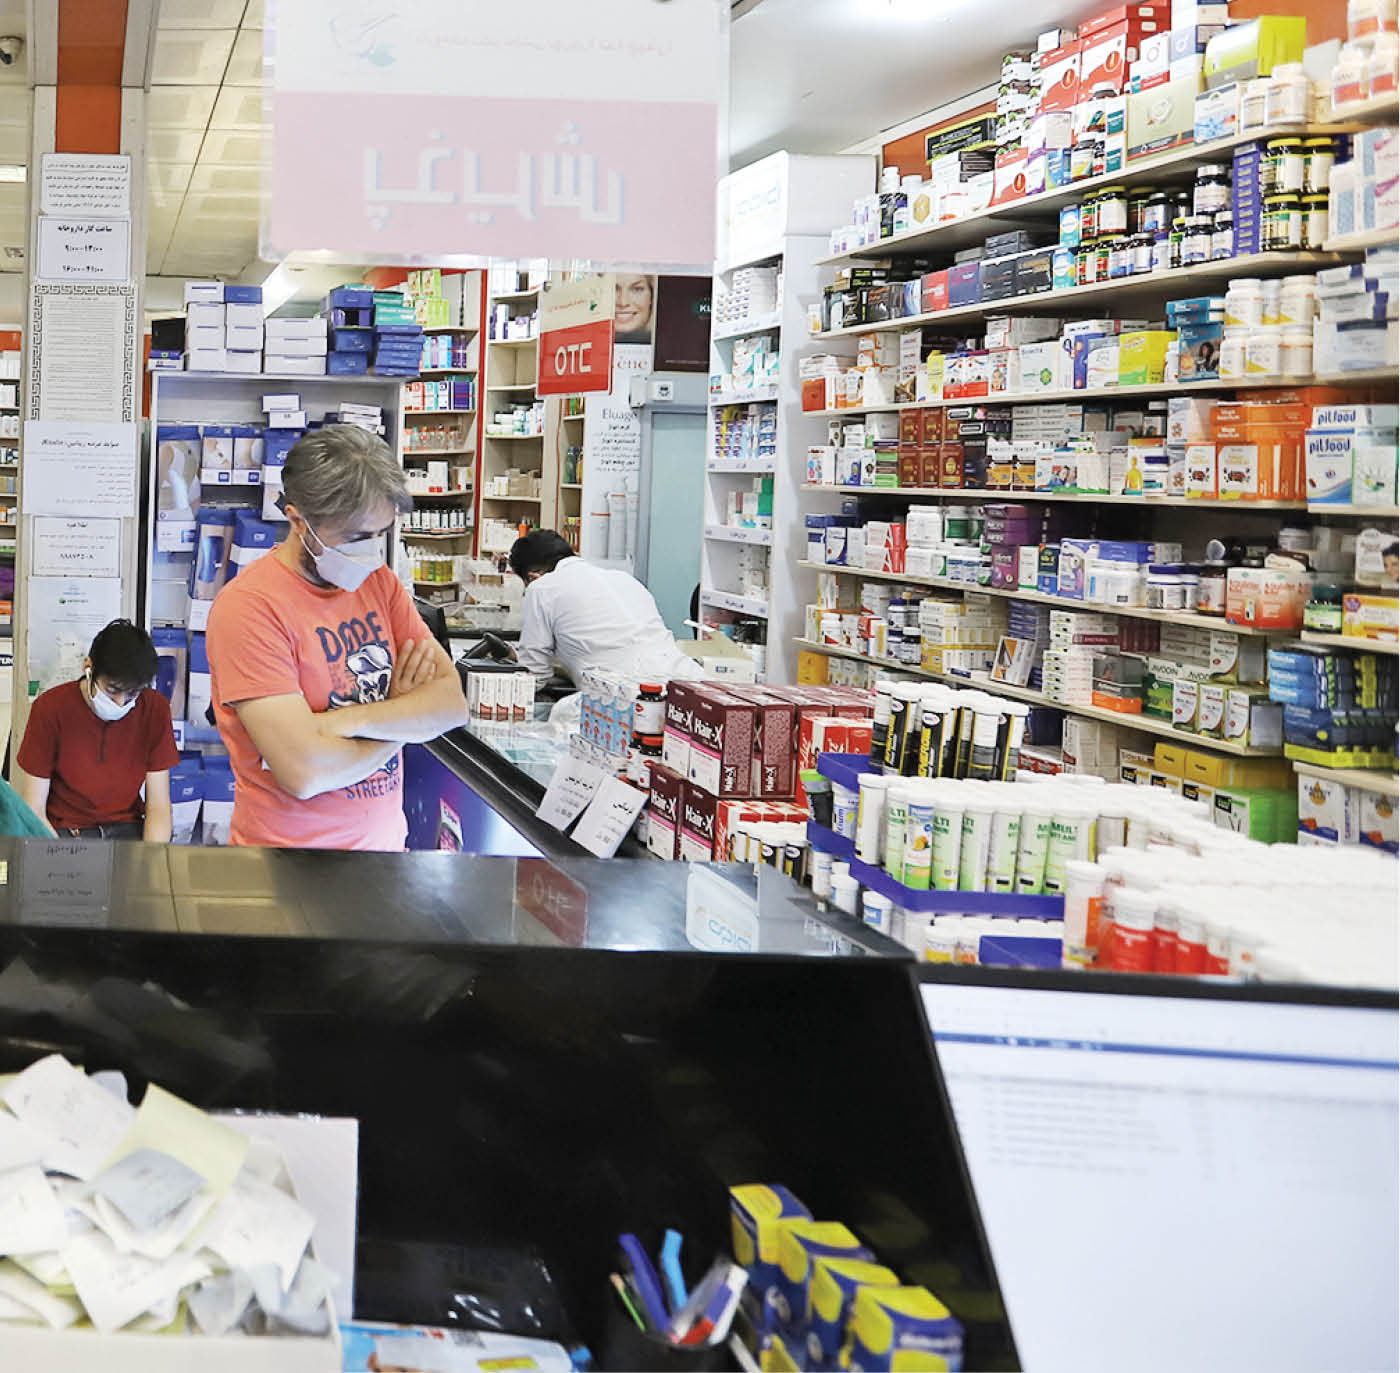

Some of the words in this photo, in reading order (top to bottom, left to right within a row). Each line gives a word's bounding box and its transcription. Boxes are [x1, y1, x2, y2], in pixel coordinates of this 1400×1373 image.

[554, 341, 593, 376] OTC
[1333, 409, 1356, 423] food
[667, 702, 694, 734] Hair-X
[694, 716, 724, 751] Hair-X
[723, 766, 737, 792] Hair-X
[765, 766, 778, 792] Hair-X
[651, 787, 678, 823] Hair-X
[933, 815, 950, 827] LTI
[685, 804, 715, 841] Hair-X
